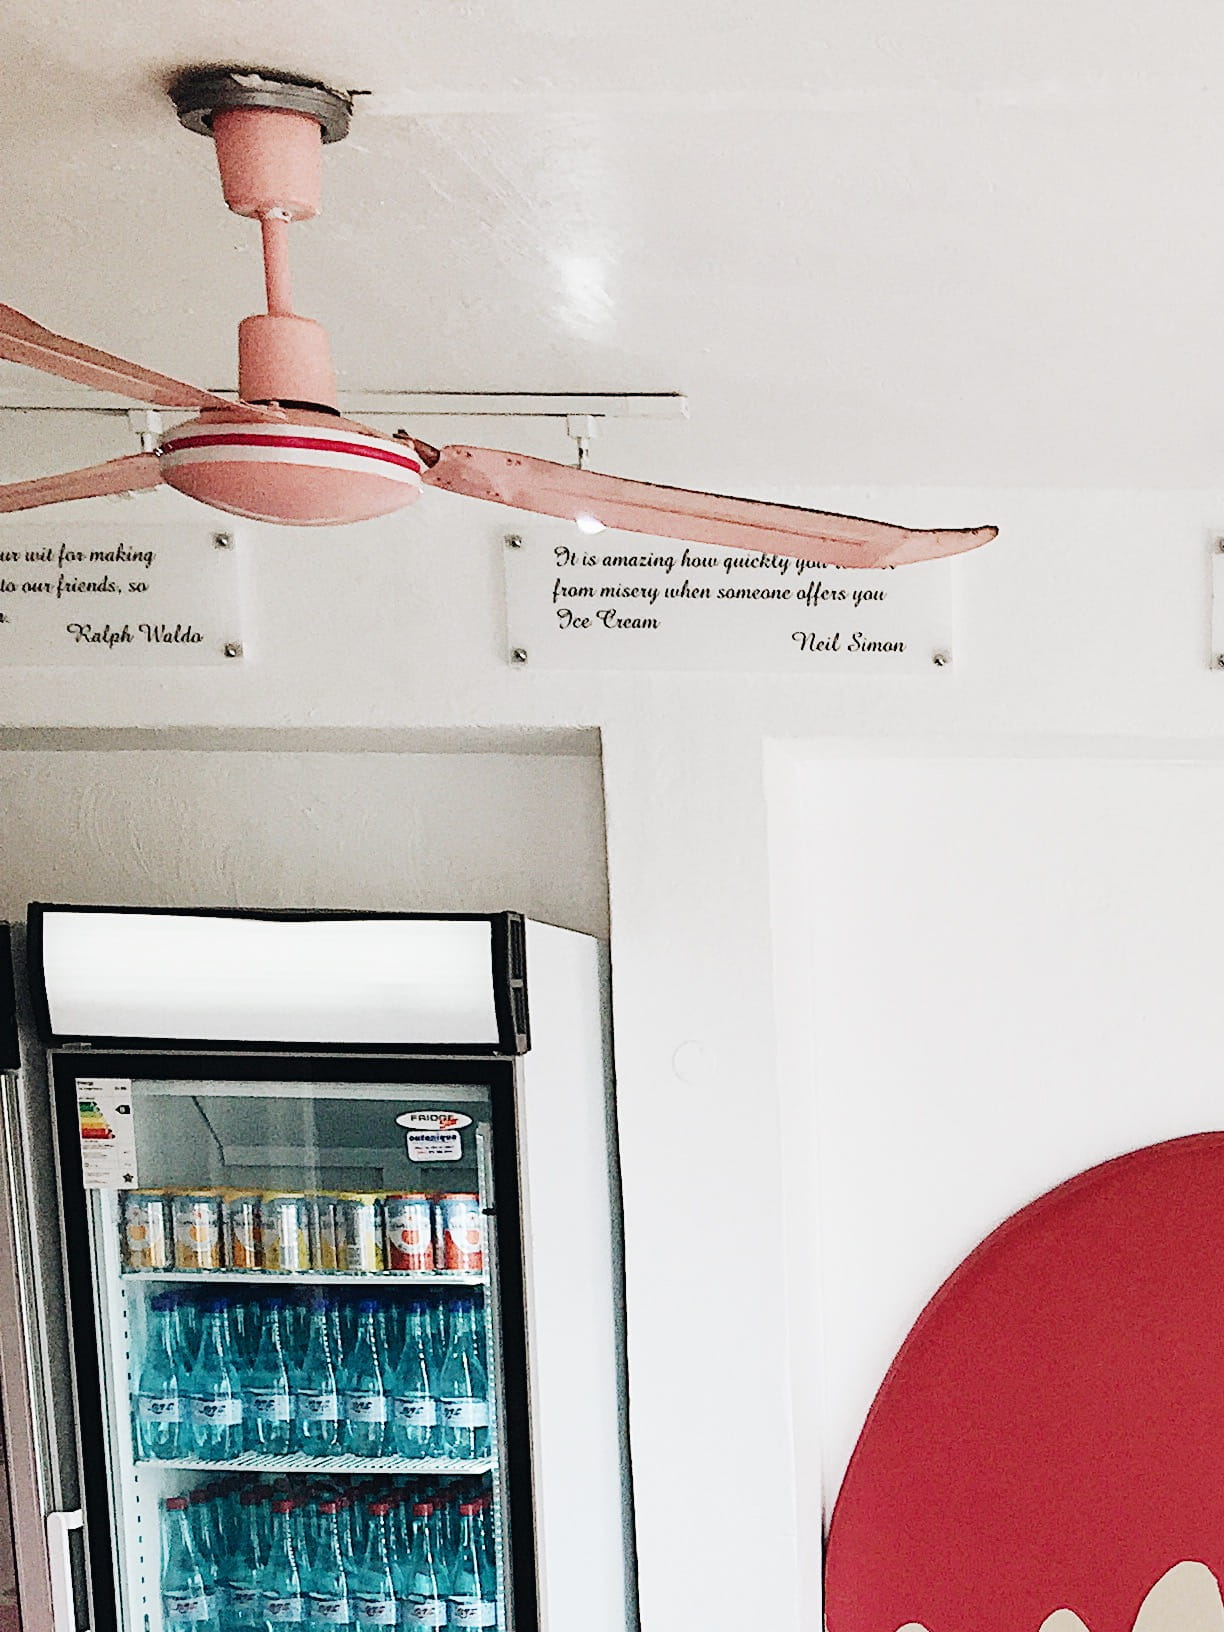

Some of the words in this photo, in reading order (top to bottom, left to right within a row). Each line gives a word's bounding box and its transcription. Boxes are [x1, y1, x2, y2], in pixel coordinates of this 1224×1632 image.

[25, 547, 54, 563] wit
[58, 542, 87, 569] for
[89, 543, 154, 569] making
[553, 546, 577, 567] It
[583, 551, 597, 567] is
[602, 552, 676, 575] amazing
[681, 548, 718, 568] how
[723, 551, 790, 576] quickly
[22, 582, 55, 594] our
[57, 573, 123, 599] friends,
[127, 582, 149, 593] so
[552, 577, 595, 604] from
[600, 582, 659, 606] misery
[664, 579, 712, 599] when
[717, 587, 792, 600] someone
[796, 580, 847, 607] offers
[852, 590, 887, 608] you
[556, 608, 592, 630] Ice
[595, 608, 661, 630] Cream
[67, 623, 135, 650] Ralph
[138, 623, 204, 644] Waldo
[791, 631, 841, 652] Neil
[847, 631, 906, 653] Simon
